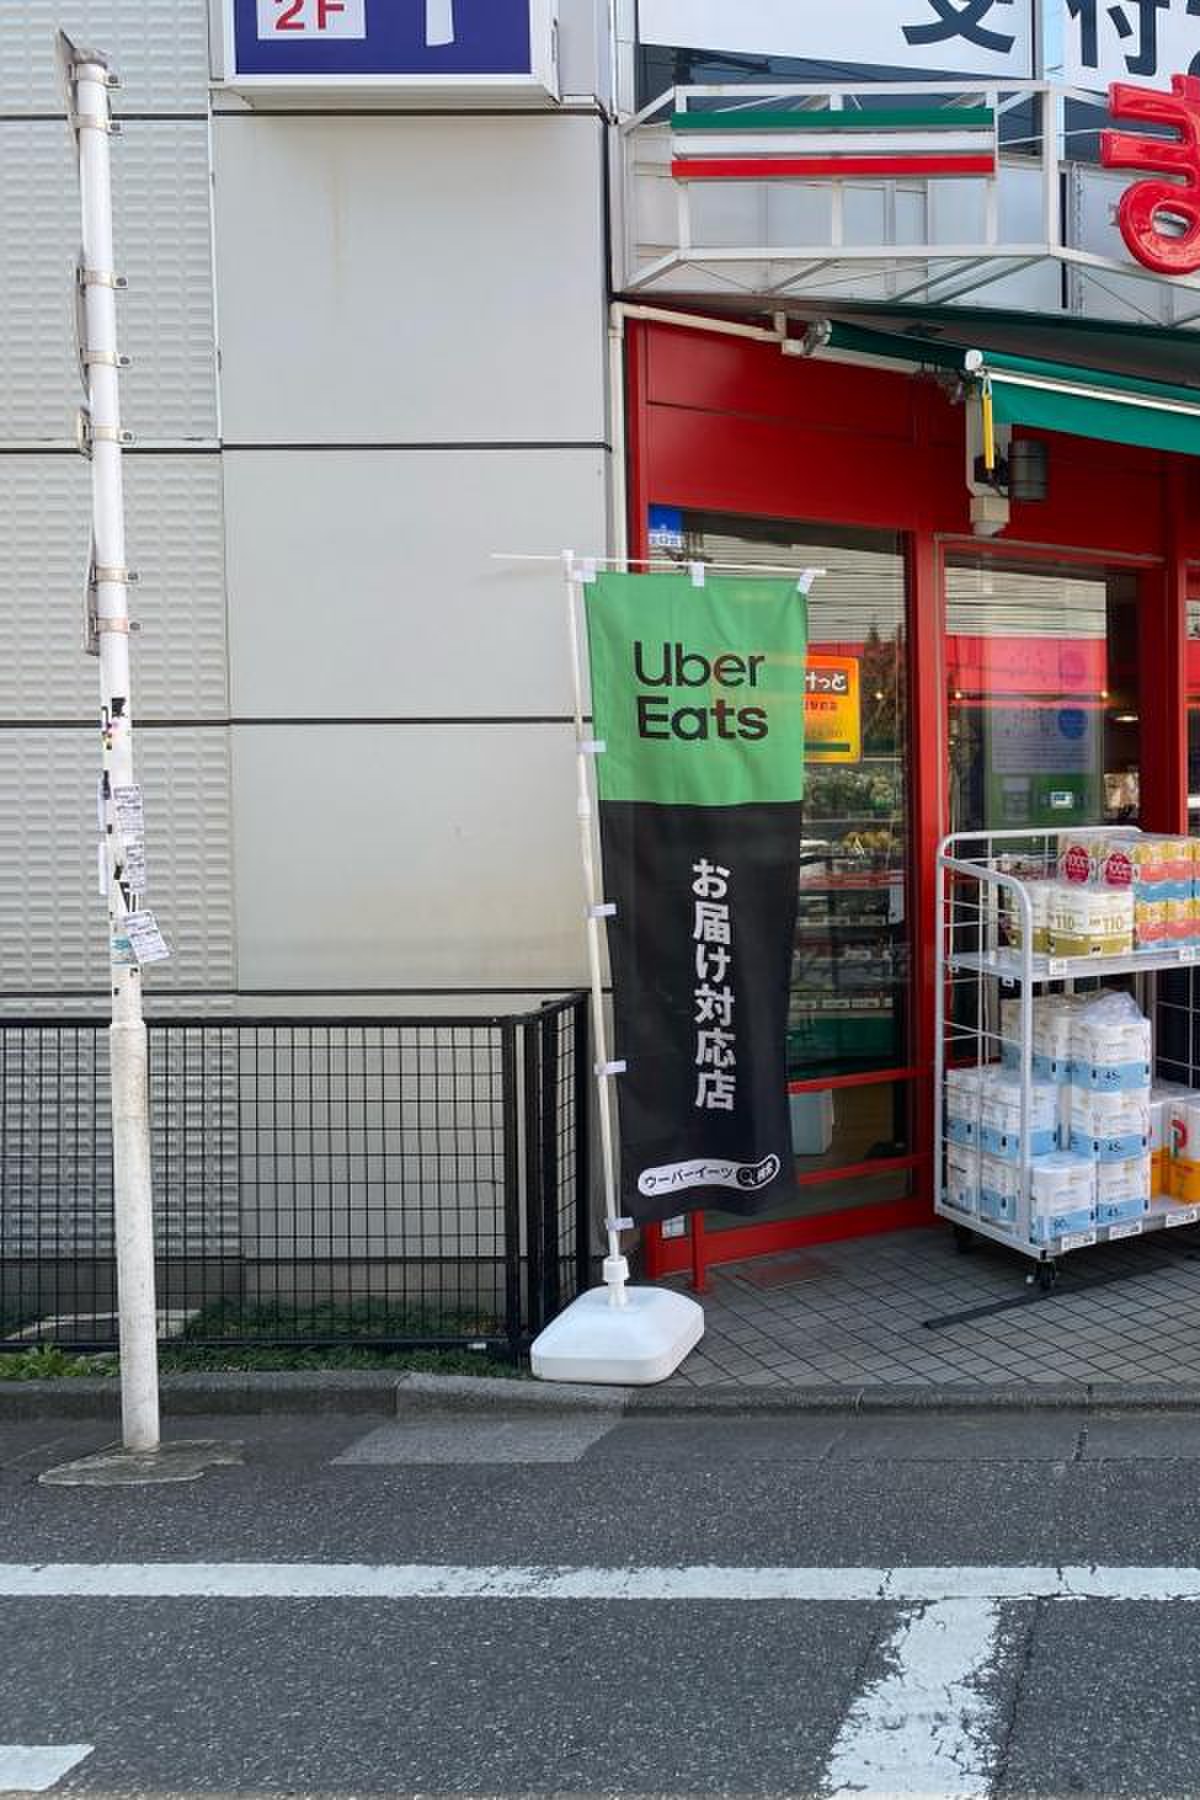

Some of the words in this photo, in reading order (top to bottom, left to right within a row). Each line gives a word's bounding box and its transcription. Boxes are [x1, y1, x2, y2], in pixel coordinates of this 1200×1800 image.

[274, 0, 345, 30] 2F
[633, 640, 766, 687] Uber
[637, 695, 768, 741] Eats
[690, 857, 738, 1112] お届け対応店
[644, 1164, 734, 1189] ウーバーイーツ
